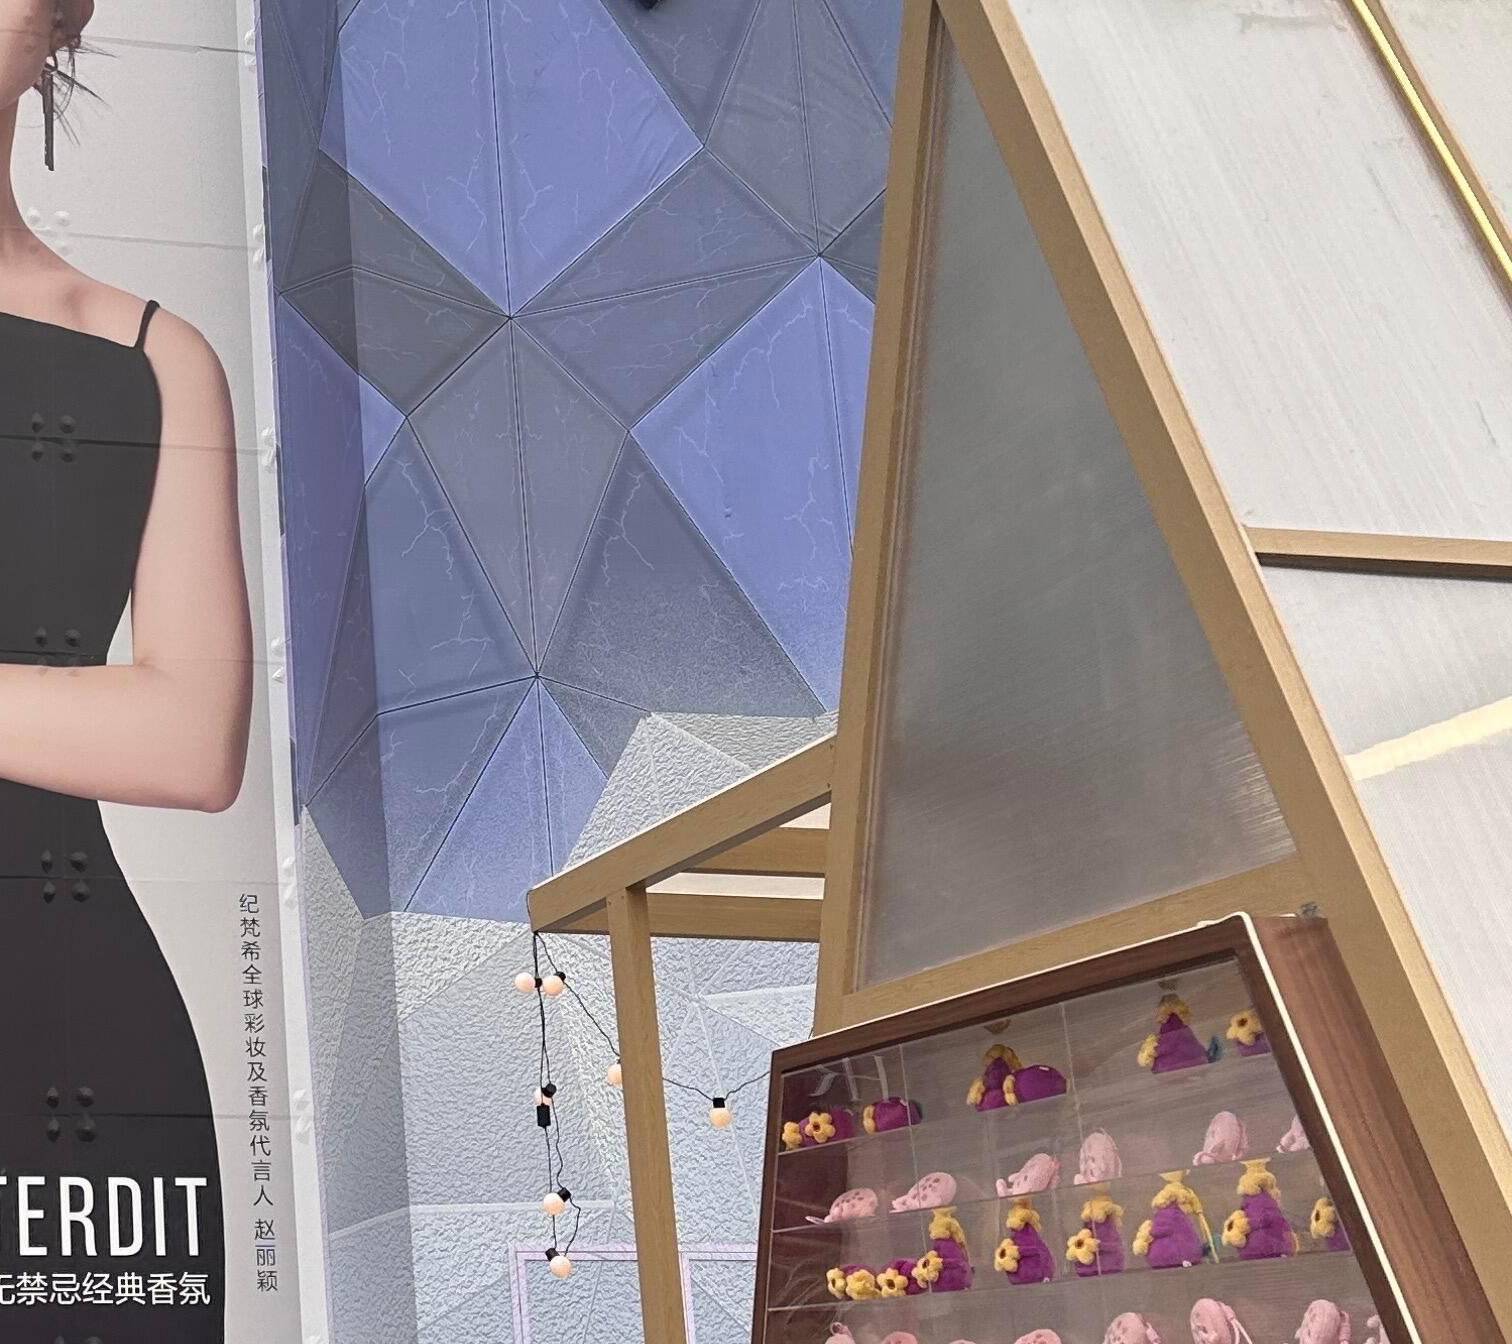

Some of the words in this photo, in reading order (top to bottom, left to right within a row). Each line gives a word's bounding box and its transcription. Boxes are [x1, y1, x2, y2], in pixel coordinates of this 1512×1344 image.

[239, 893, 274, 1207] 纪梵希全球彩妆及香氛代言人
[254, 1218, 278, 1293] 赵丽颖
